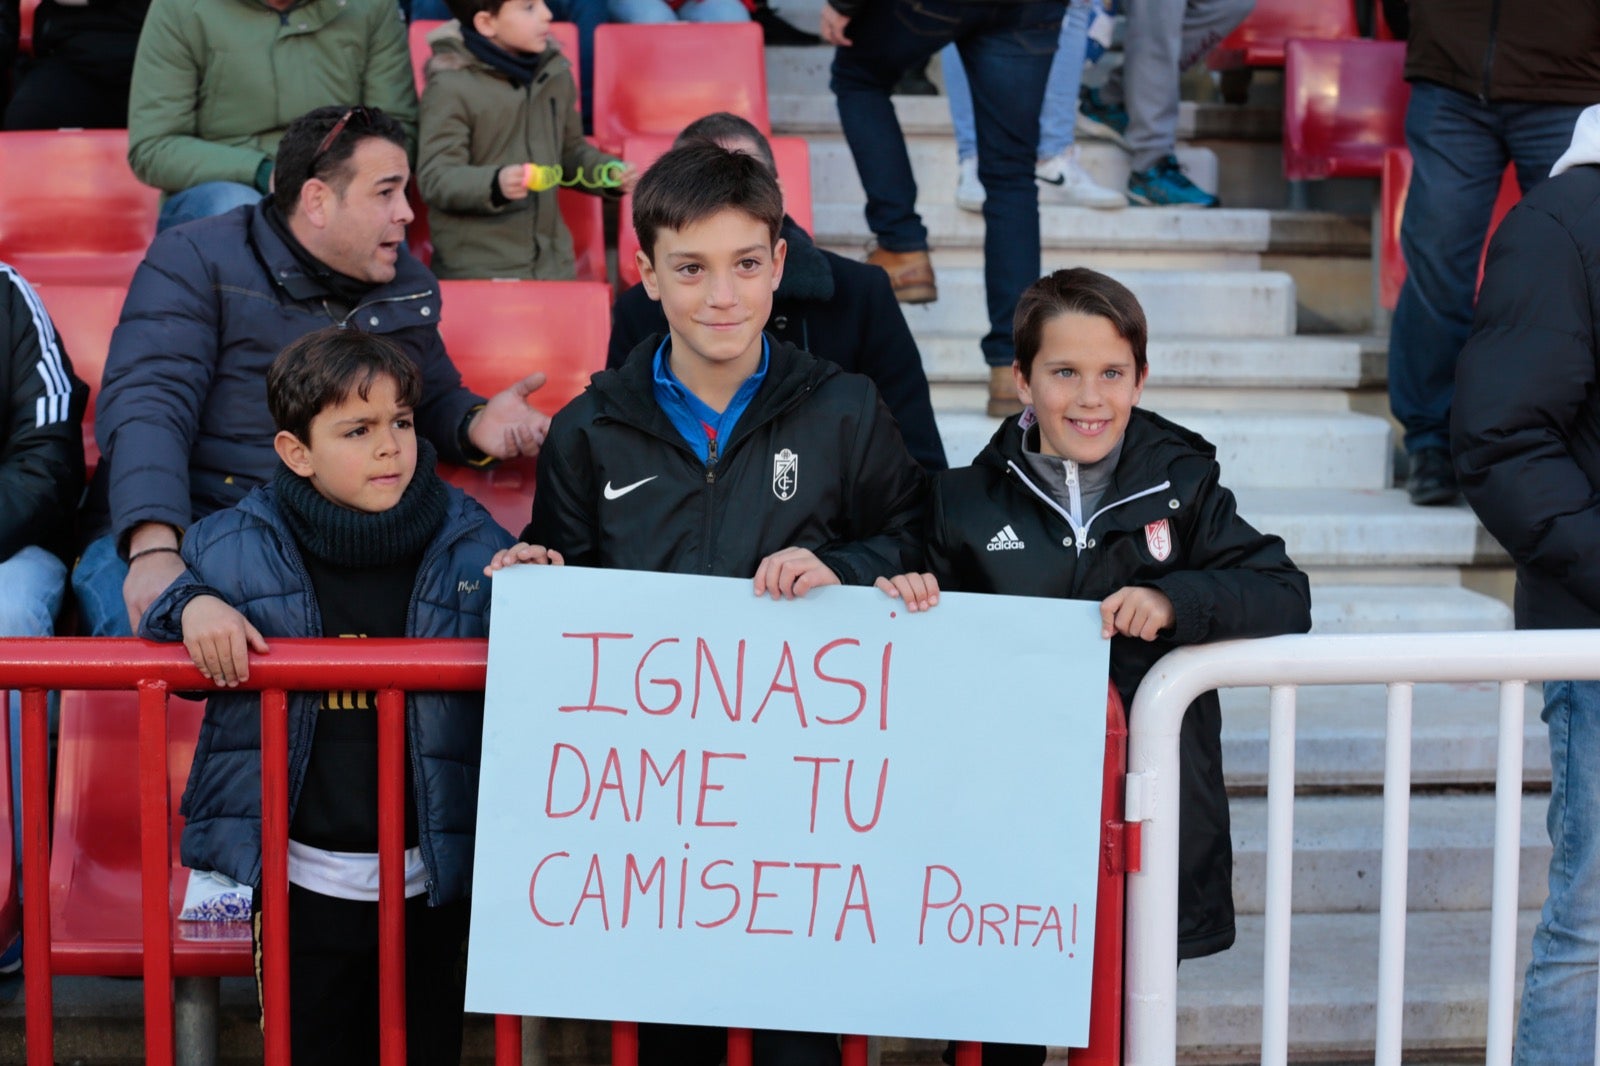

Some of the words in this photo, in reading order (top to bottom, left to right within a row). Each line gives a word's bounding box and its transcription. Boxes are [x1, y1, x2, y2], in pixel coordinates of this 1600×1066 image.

[986, 540, 1025, 551] adidas
[545, 742, 747, 827] DAME
[793, 755, 890, 833] TU
[919, 865, 1077, 959] PORFA!
